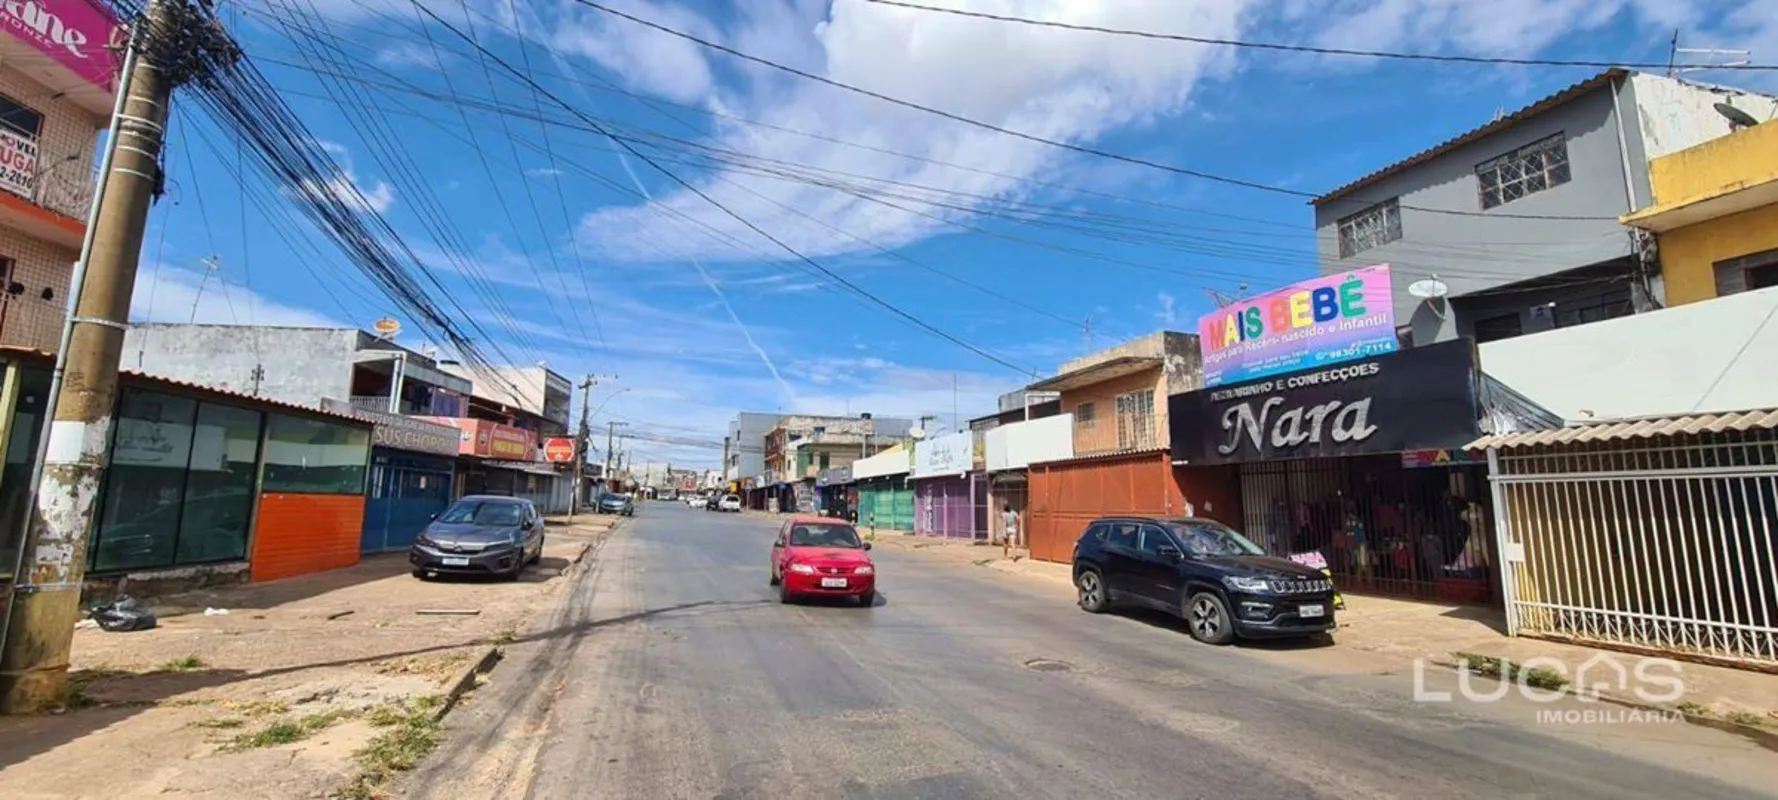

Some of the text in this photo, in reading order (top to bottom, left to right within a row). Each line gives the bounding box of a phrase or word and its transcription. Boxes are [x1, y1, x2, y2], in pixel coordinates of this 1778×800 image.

[1209, 275, 1367, 351] MAIS BEBÊ
[1340, 313, 1387, 331] Infantil
[1276, 379, 1285, 390] E
[1217, 396, 1379, 455] Nara
